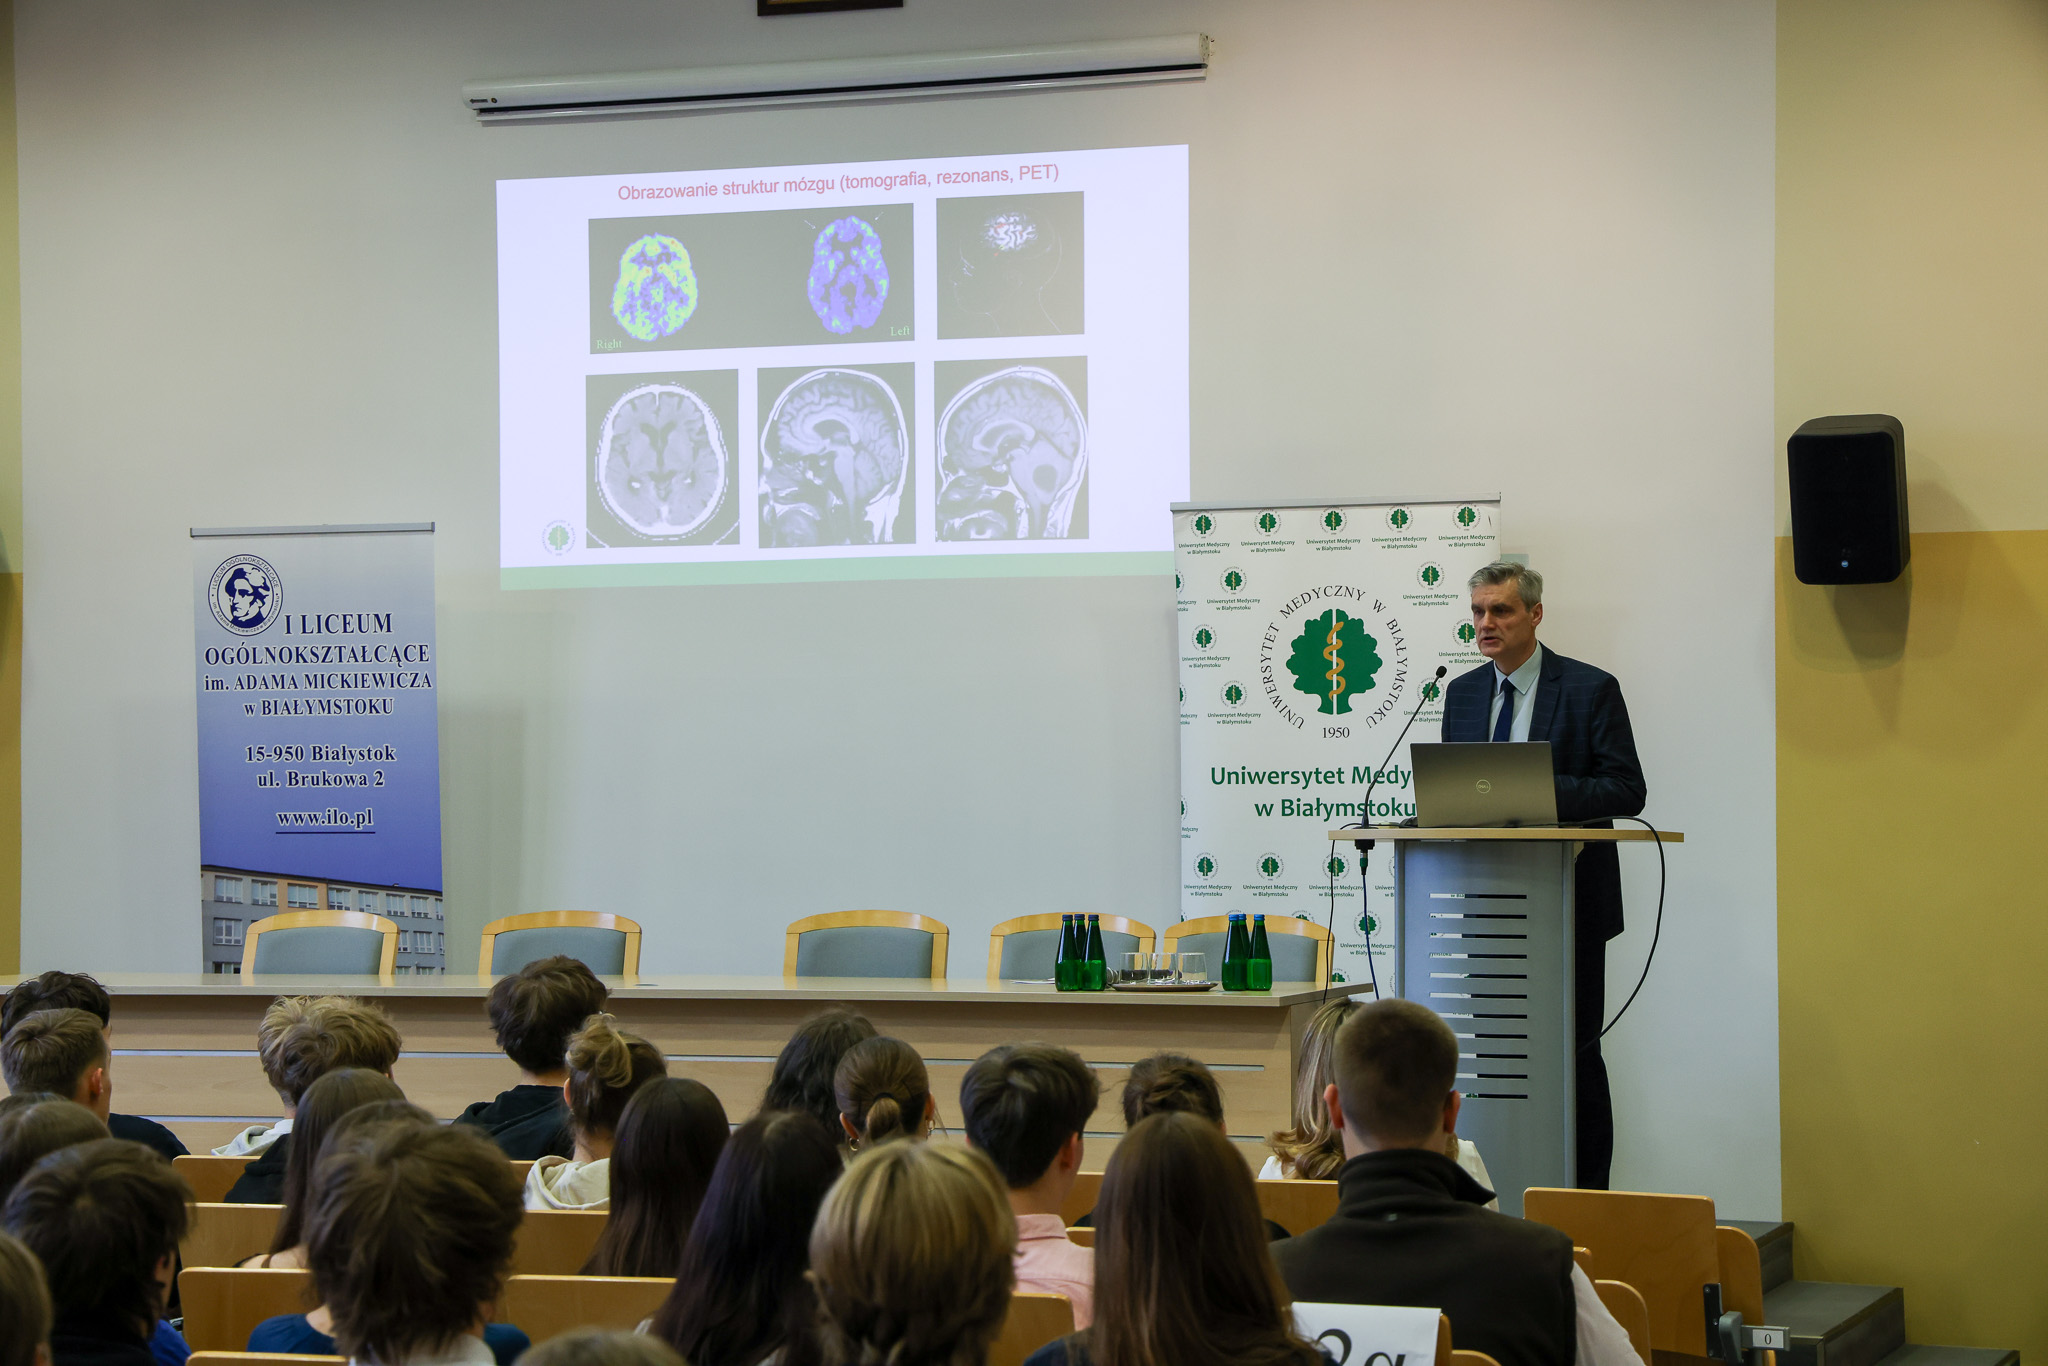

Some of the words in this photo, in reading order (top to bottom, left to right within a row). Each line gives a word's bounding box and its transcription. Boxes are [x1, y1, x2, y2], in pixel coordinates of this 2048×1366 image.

[618, 182, 718, 200] Obrazowanie
[722, 180, 780, 195] struktur
[784, 177, 835, 194] mózgu
[839, 170, 932, 193] (tomografia,
[936, 168, 1014, 184] rezonans,
[1018, 164, 1060, 182] PET)
[890, 325, 910, 336] Left
[597, 339, 623, 351] Right
[1280, 585, 1366, 619] MEDYCZNY
[1372, 599, 1386, 613] W
[284, 615, 292, 635] I
[301, 613, 393, 635] LICEUM
[205, 642, 430, 667] OGÓLNOKSZTAŁCĄCE
[205, 675, 229, 691] im.
[234, 674, 299, 691] ADAMA
[303, 672, 432, 690] MICKIEWICZA
[1260, 622, 1305, 729] UNIWERSYTET
[1365, 618, 1408, 728] BIAŁYMSTOKU
[244, 703, 256, 716] w
[262, 698, 394, 716] BIAŁYMSTOKU
[1322, 727, 1350, 738] 1950
[246, 745, 305, 762] 15-950
[311, 745, 396, 765] Białystok
[257, 772, 280, 788] ul.
[286, 771, 369, 788] Brukowa
[374, 770, 385, 787] 2
[1211, 766, 1345, 790] Uniwersytet
[1351, 764, 1412, 790] Medy
[277, 809, 374, 829] www.ilo.pl
[1254, 802, 1274, 817] w
[1281, 797, 1416, 822] Białymstoku
[1765, 1333, 1771, 1345] 0
